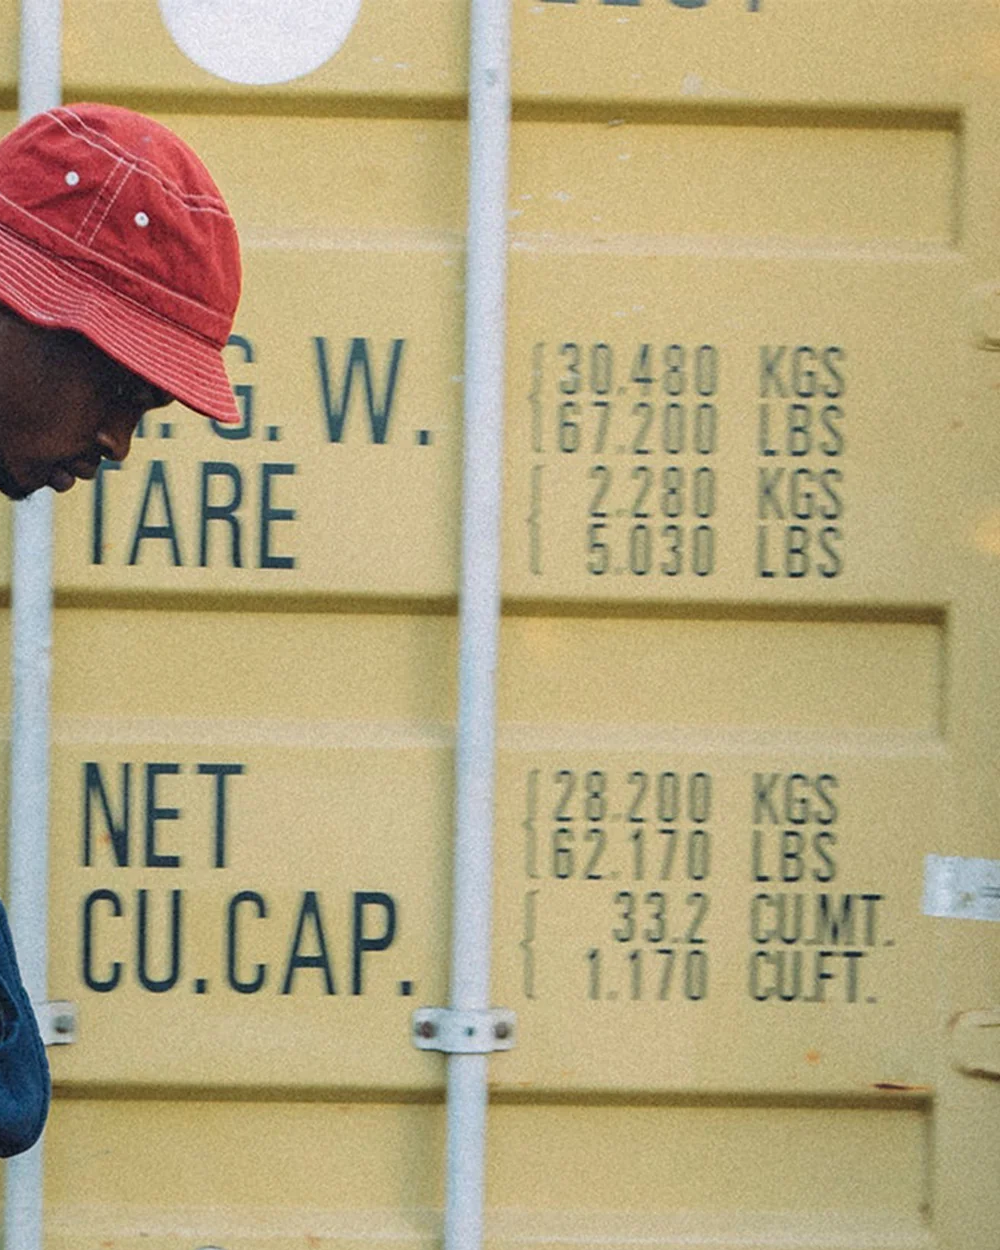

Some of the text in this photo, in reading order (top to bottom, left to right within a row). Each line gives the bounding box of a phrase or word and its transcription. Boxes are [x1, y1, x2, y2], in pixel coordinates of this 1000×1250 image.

[559, 342, 845, 398] 30.480 KGS
[558, 401, 844, 456] 67.200 LBS
[92, 460, 295, 569] TARE
[587, 465, 843, 520] 2.280 KGS
[587, 523, 842, 578] 5.030 LBS
[84, 762, 245, 868] NET
[554, 770, 838, 825] 28.200 KGS
[553, 828, 836, 882] 62.170 LBS
[83, 889, 413, 996] CU.CAP.
[612, 892, 895, 947] 33.2 CU.MT.
[587, 949, 877, 1003] 1.170 CU.FT.
